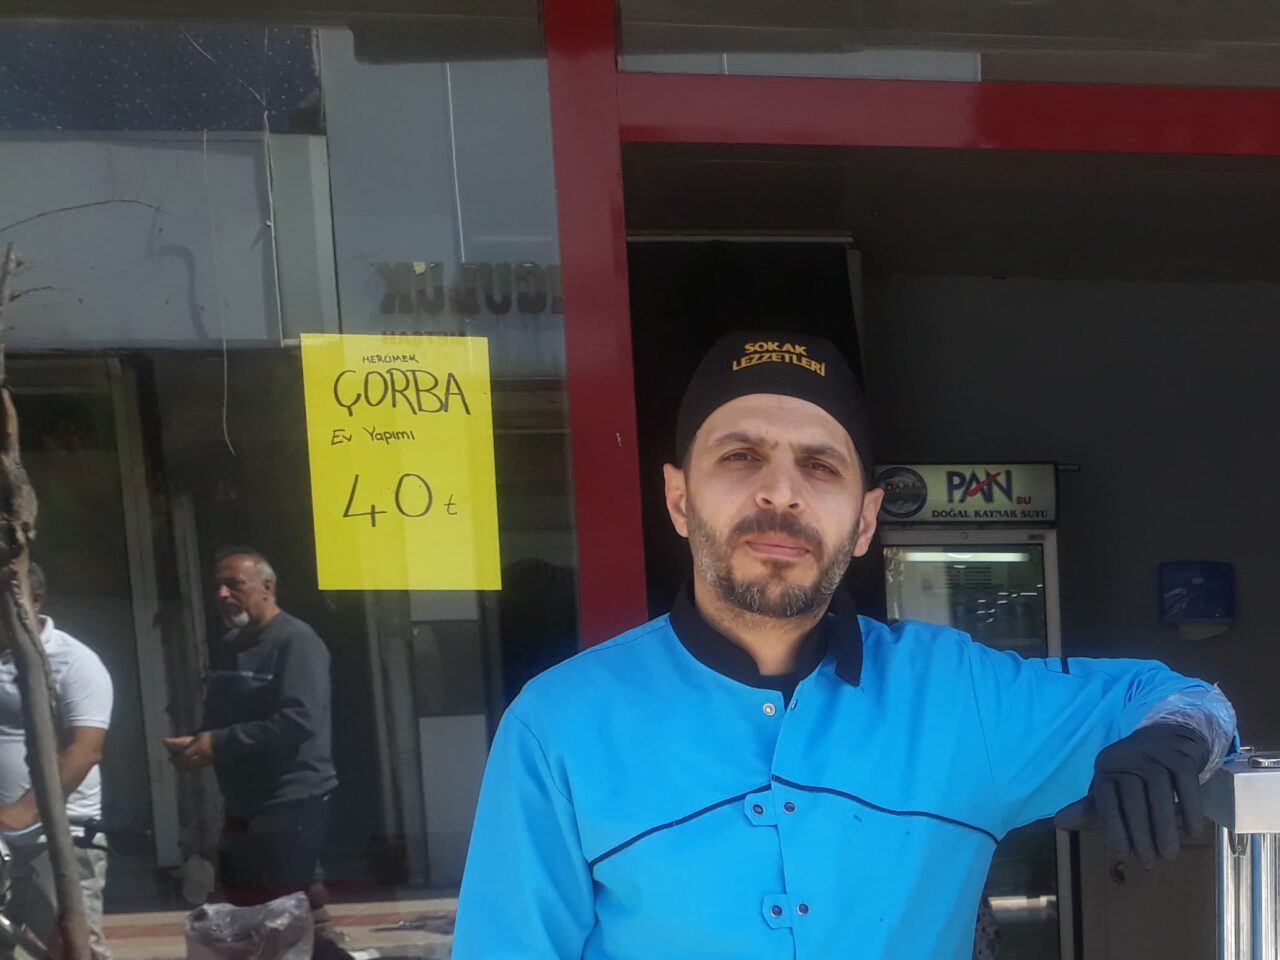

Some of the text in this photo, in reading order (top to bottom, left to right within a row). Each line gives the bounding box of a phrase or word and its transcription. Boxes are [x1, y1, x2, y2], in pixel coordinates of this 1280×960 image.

[744, 341, 808, 355] SOKAK
[732, 352, 826, 377] LEZZETLERİ
[333, 368, 471, 417] ÇORBA
[331, 426, 416, 445] Ev Yapımı
[946, 470, 1014, 504] PAN
[932, 507, 1049, 519] DOĞAL KAYNAK SUYU
